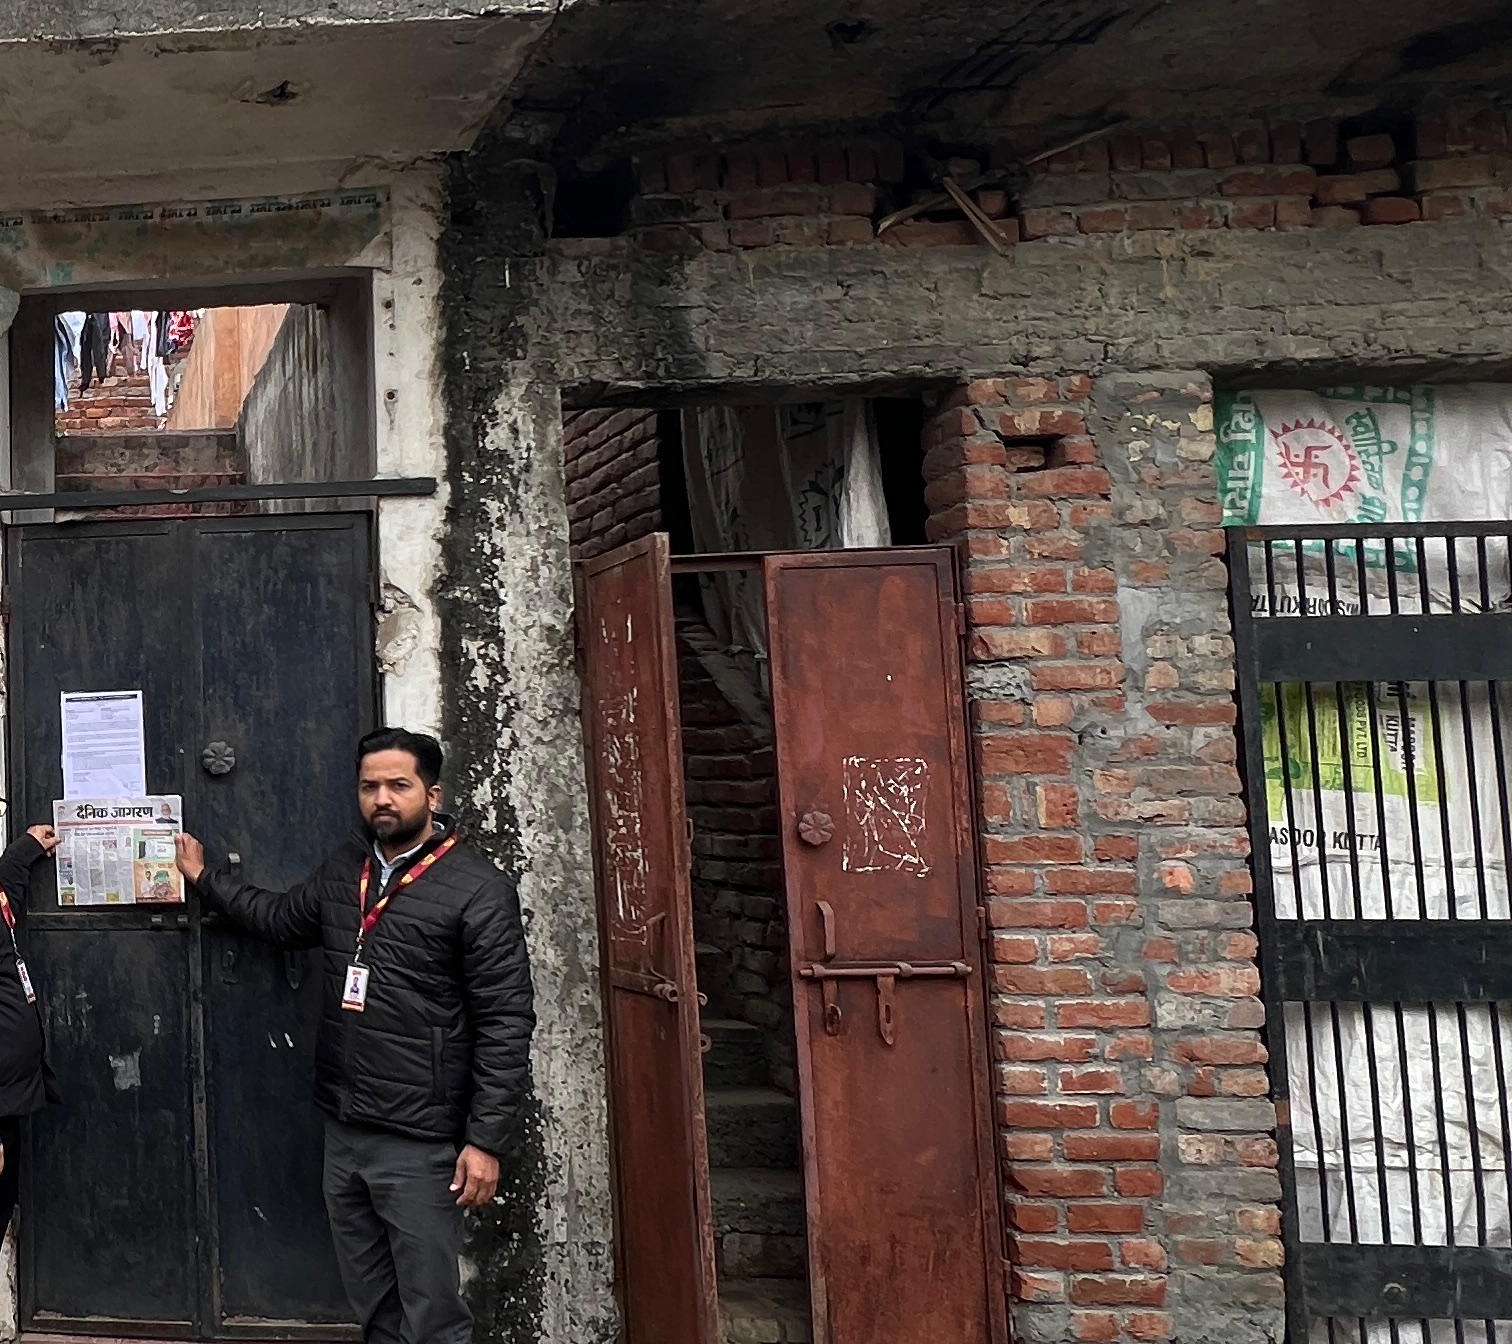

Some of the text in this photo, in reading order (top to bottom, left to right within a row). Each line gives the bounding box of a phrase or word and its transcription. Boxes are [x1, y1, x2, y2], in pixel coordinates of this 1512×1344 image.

[1250, 594, 1301, 613] KUTA
[1385, 714, 1399, 752] KUTTA
[76, 804, 153, 819] दैनिक जागरण
[1269, 826, 1326, 848] ASOO
